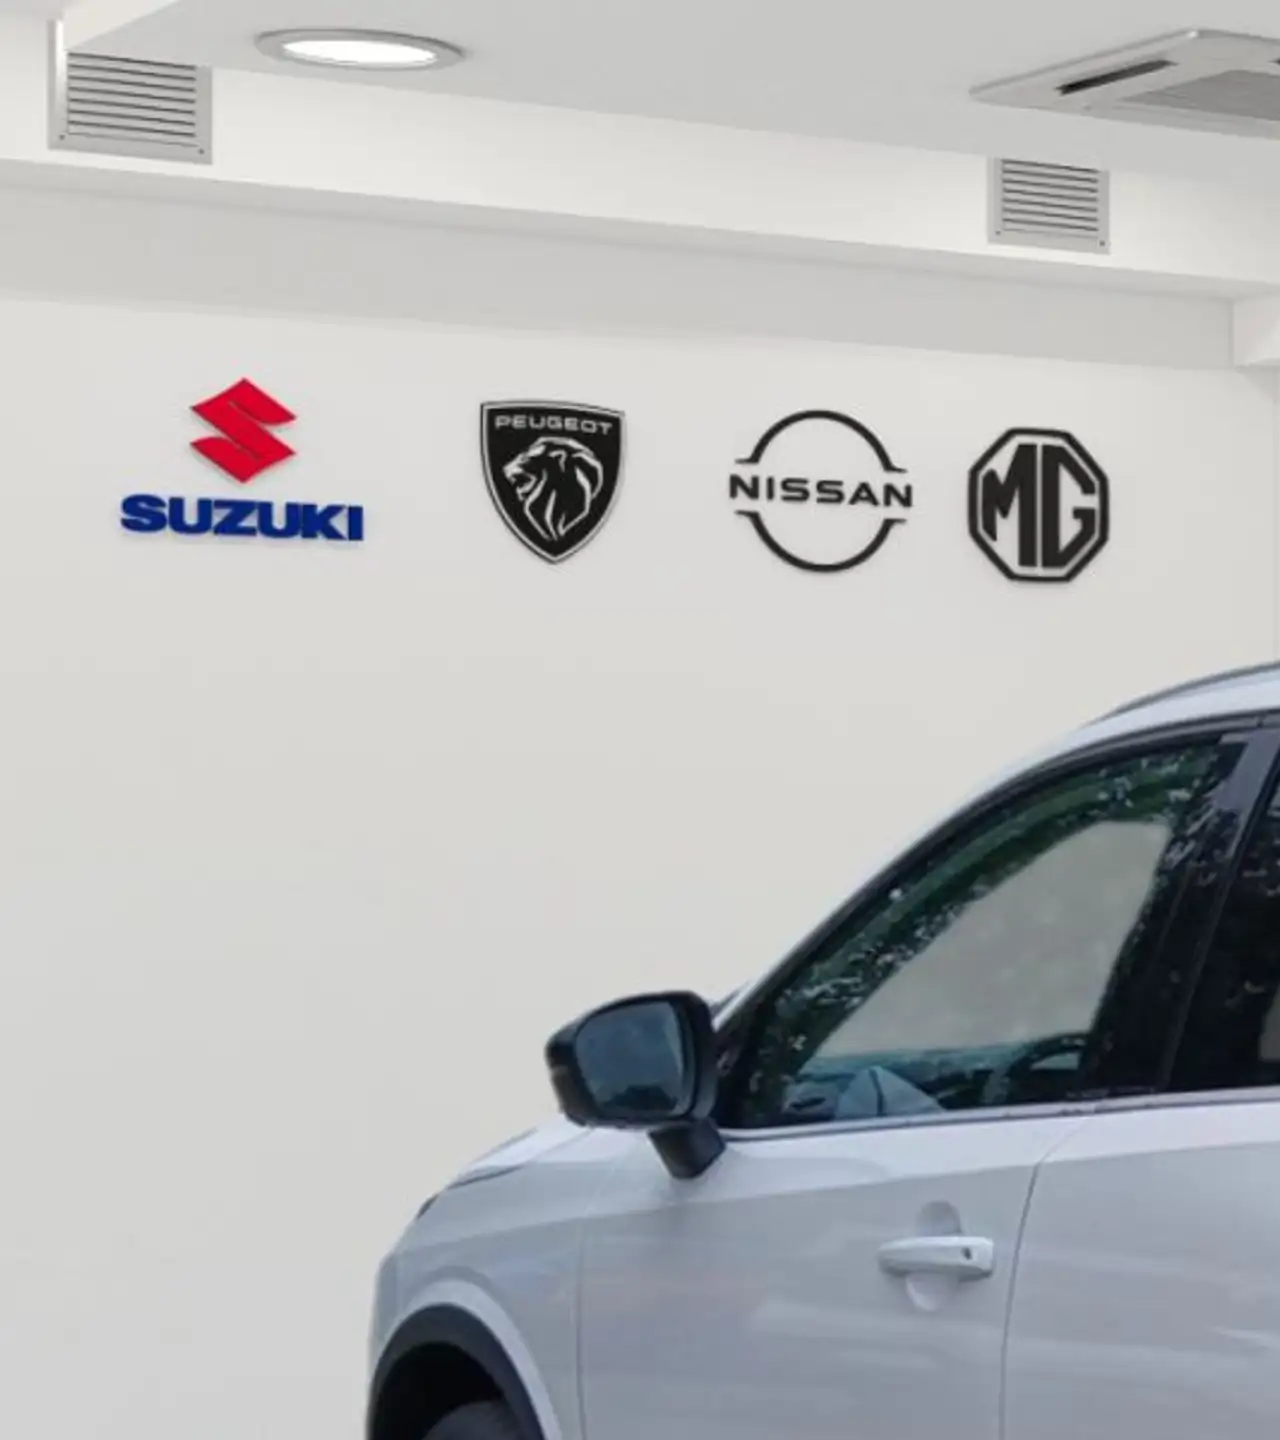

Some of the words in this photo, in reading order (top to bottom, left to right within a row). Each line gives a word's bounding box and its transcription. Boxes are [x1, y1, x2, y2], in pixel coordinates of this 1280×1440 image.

[494, 414, 613, 435] PEUGEOT
[729, 473, 914, 509] NISSAN
[981, 443, 1097, 569] MG
[120, 492, 364, 541] SUZUKI
